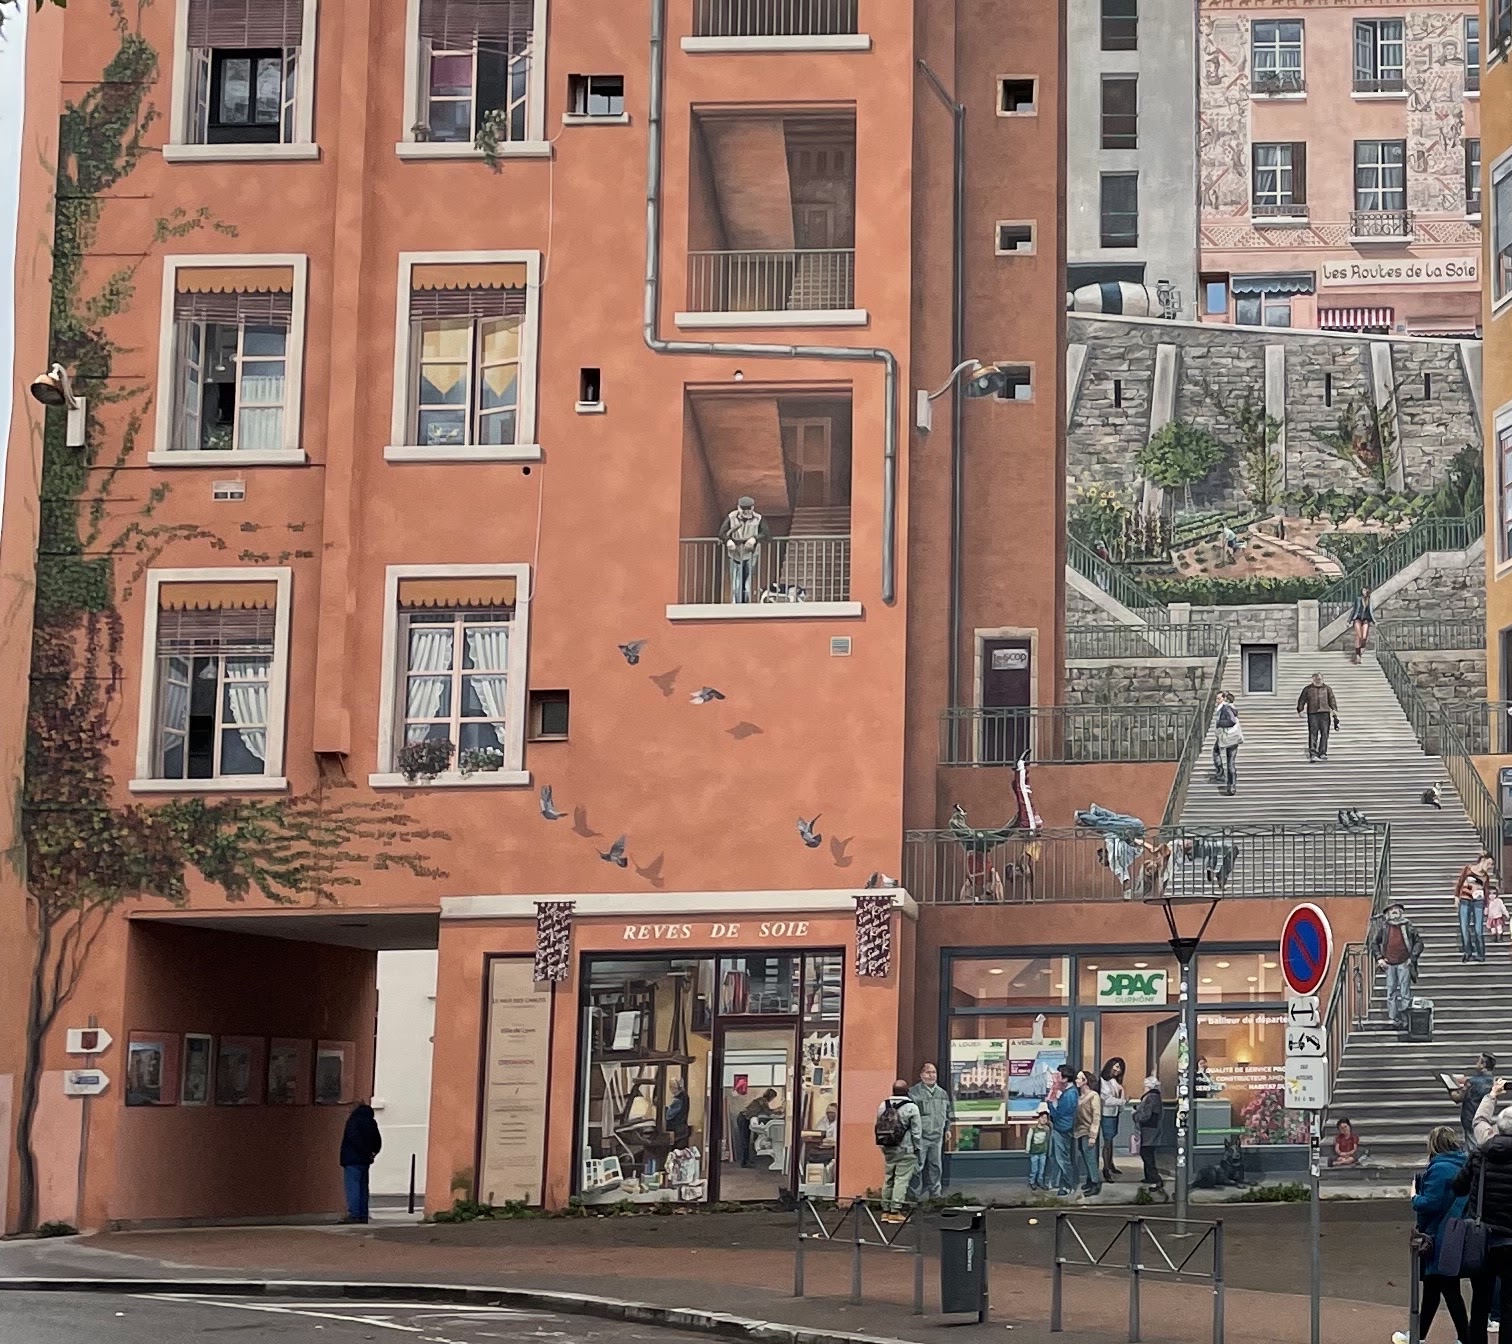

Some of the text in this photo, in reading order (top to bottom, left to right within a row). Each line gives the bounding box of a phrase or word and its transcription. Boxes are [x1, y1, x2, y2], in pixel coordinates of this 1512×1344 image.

[1323, 264, 1347, 280] Les
[1350, 263, 1402, 280] Routes
[1406, 263, 1422, 278] de
[1445, 260, 1476, 277] Soie
[623, 921, 810, 941] REVES DE SOIE
